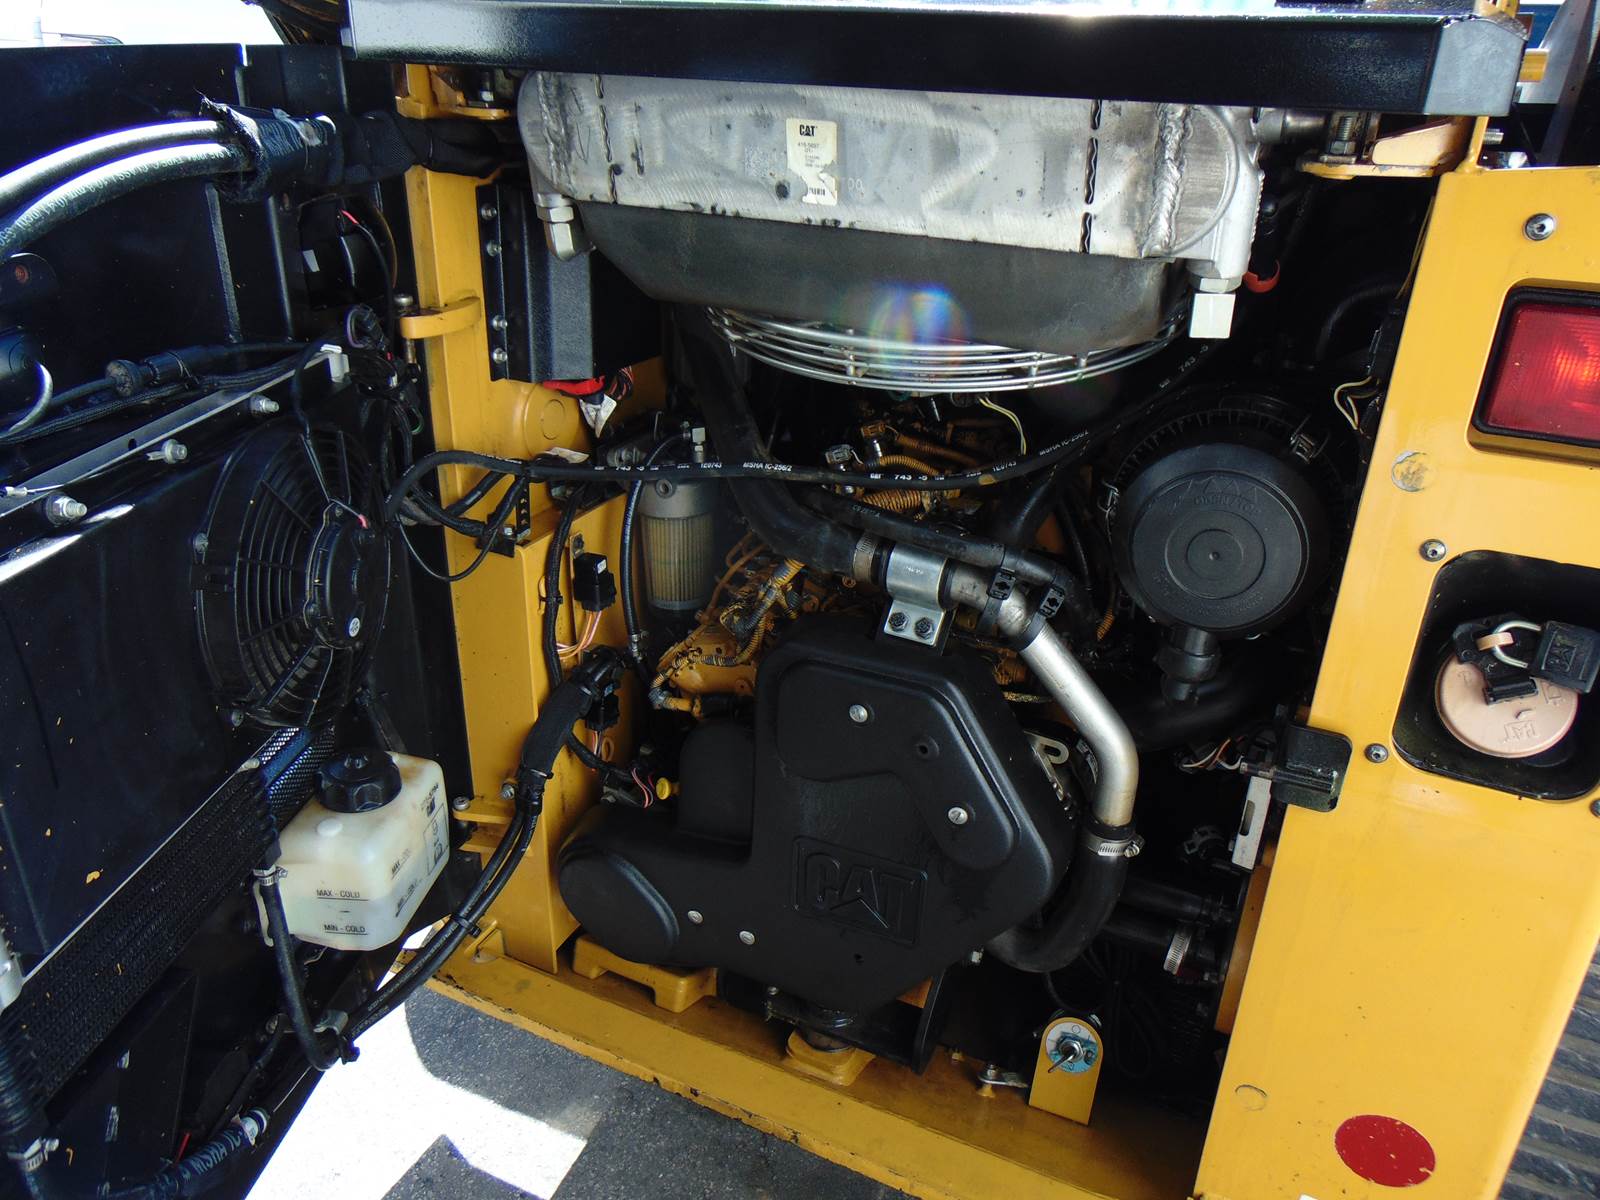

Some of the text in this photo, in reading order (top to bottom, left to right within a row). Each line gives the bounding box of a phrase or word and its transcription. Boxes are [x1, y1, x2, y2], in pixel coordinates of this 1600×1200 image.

[799, 124, 816, 137] CAT
[316, 889, 333, 897] MAX
[339, 890, 361, 898] COLD
[804, 852, 914, 934] CAT
[323, 924, 339, 932] MIN
[345, 925, 366, 933] COLD
